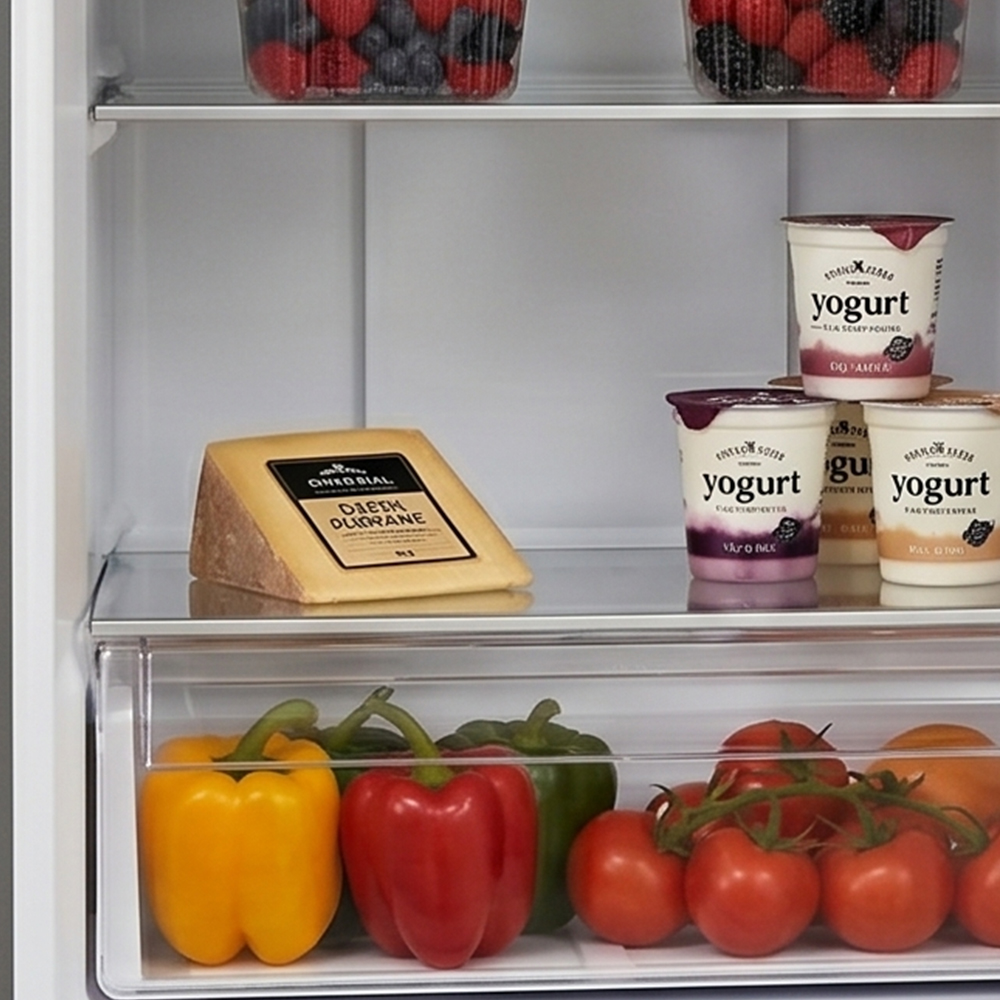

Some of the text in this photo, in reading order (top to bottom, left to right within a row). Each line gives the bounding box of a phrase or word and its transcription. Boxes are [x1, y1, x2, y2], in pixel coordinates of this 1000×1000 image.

[811, 291, 909, 323] yogurt
[702, 471, 800, 504] yogurt
[891, 471, 990, 505] yogurt
